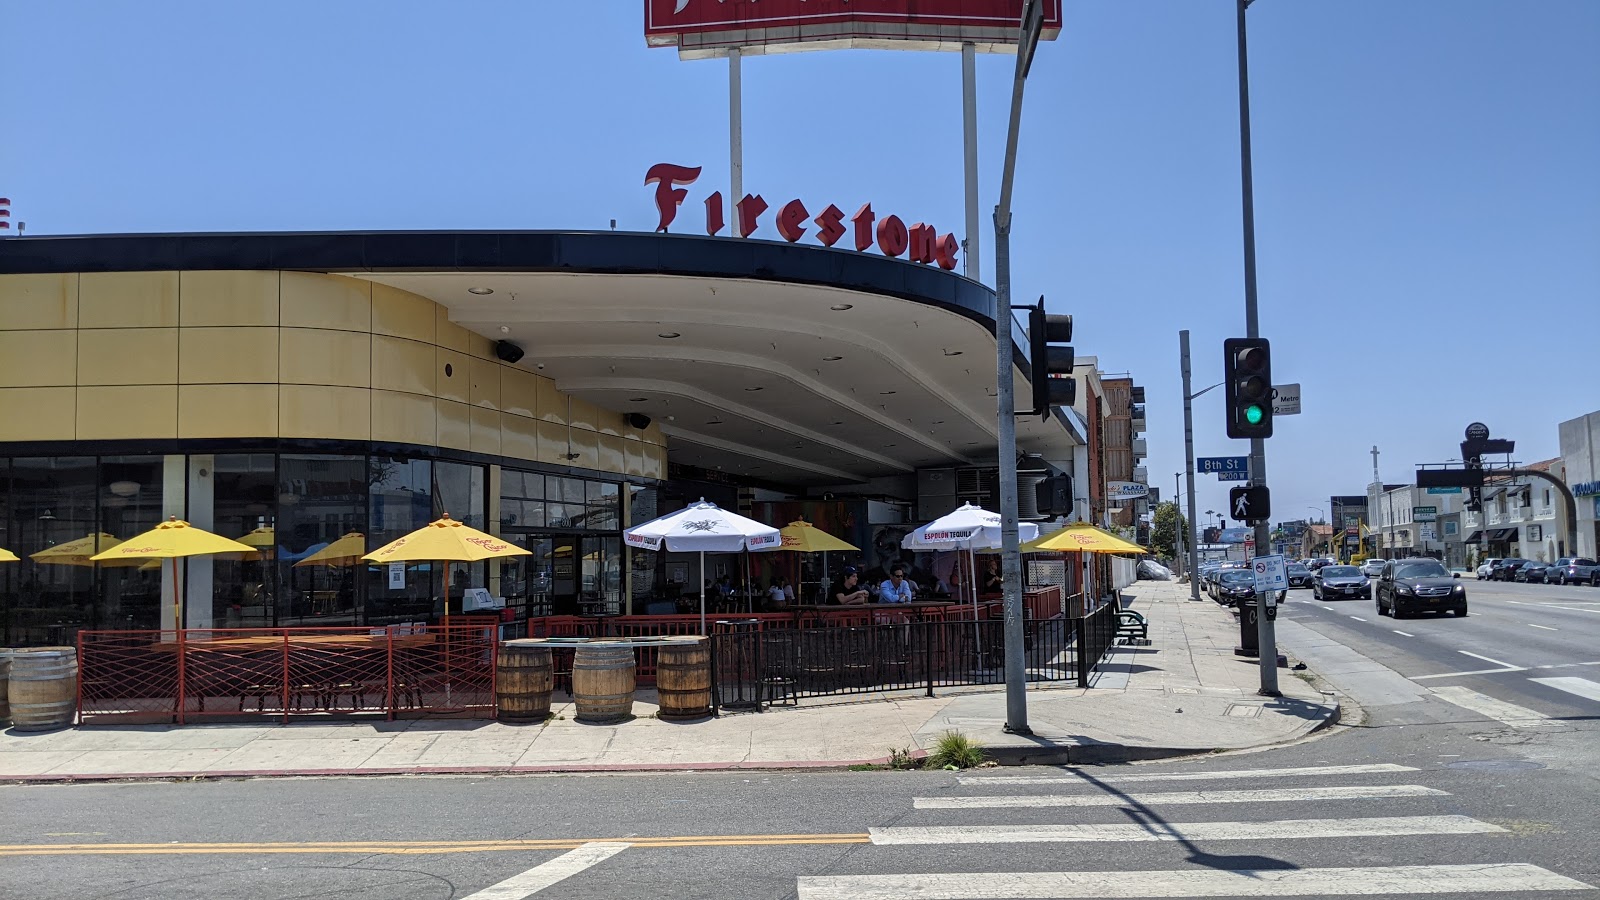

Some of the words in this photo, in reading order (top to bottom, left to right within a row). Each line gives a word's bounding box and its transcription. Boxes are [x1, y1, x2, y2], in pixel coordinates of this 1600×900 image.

[644, 163, 959, 270] Firestone
[1204, 459, 1222, 470] 8th
[1226, 458, 1239, 469] St
[1219, 472, 1238, 480] 200
[950, 530, 972, 538] TEQUILA
